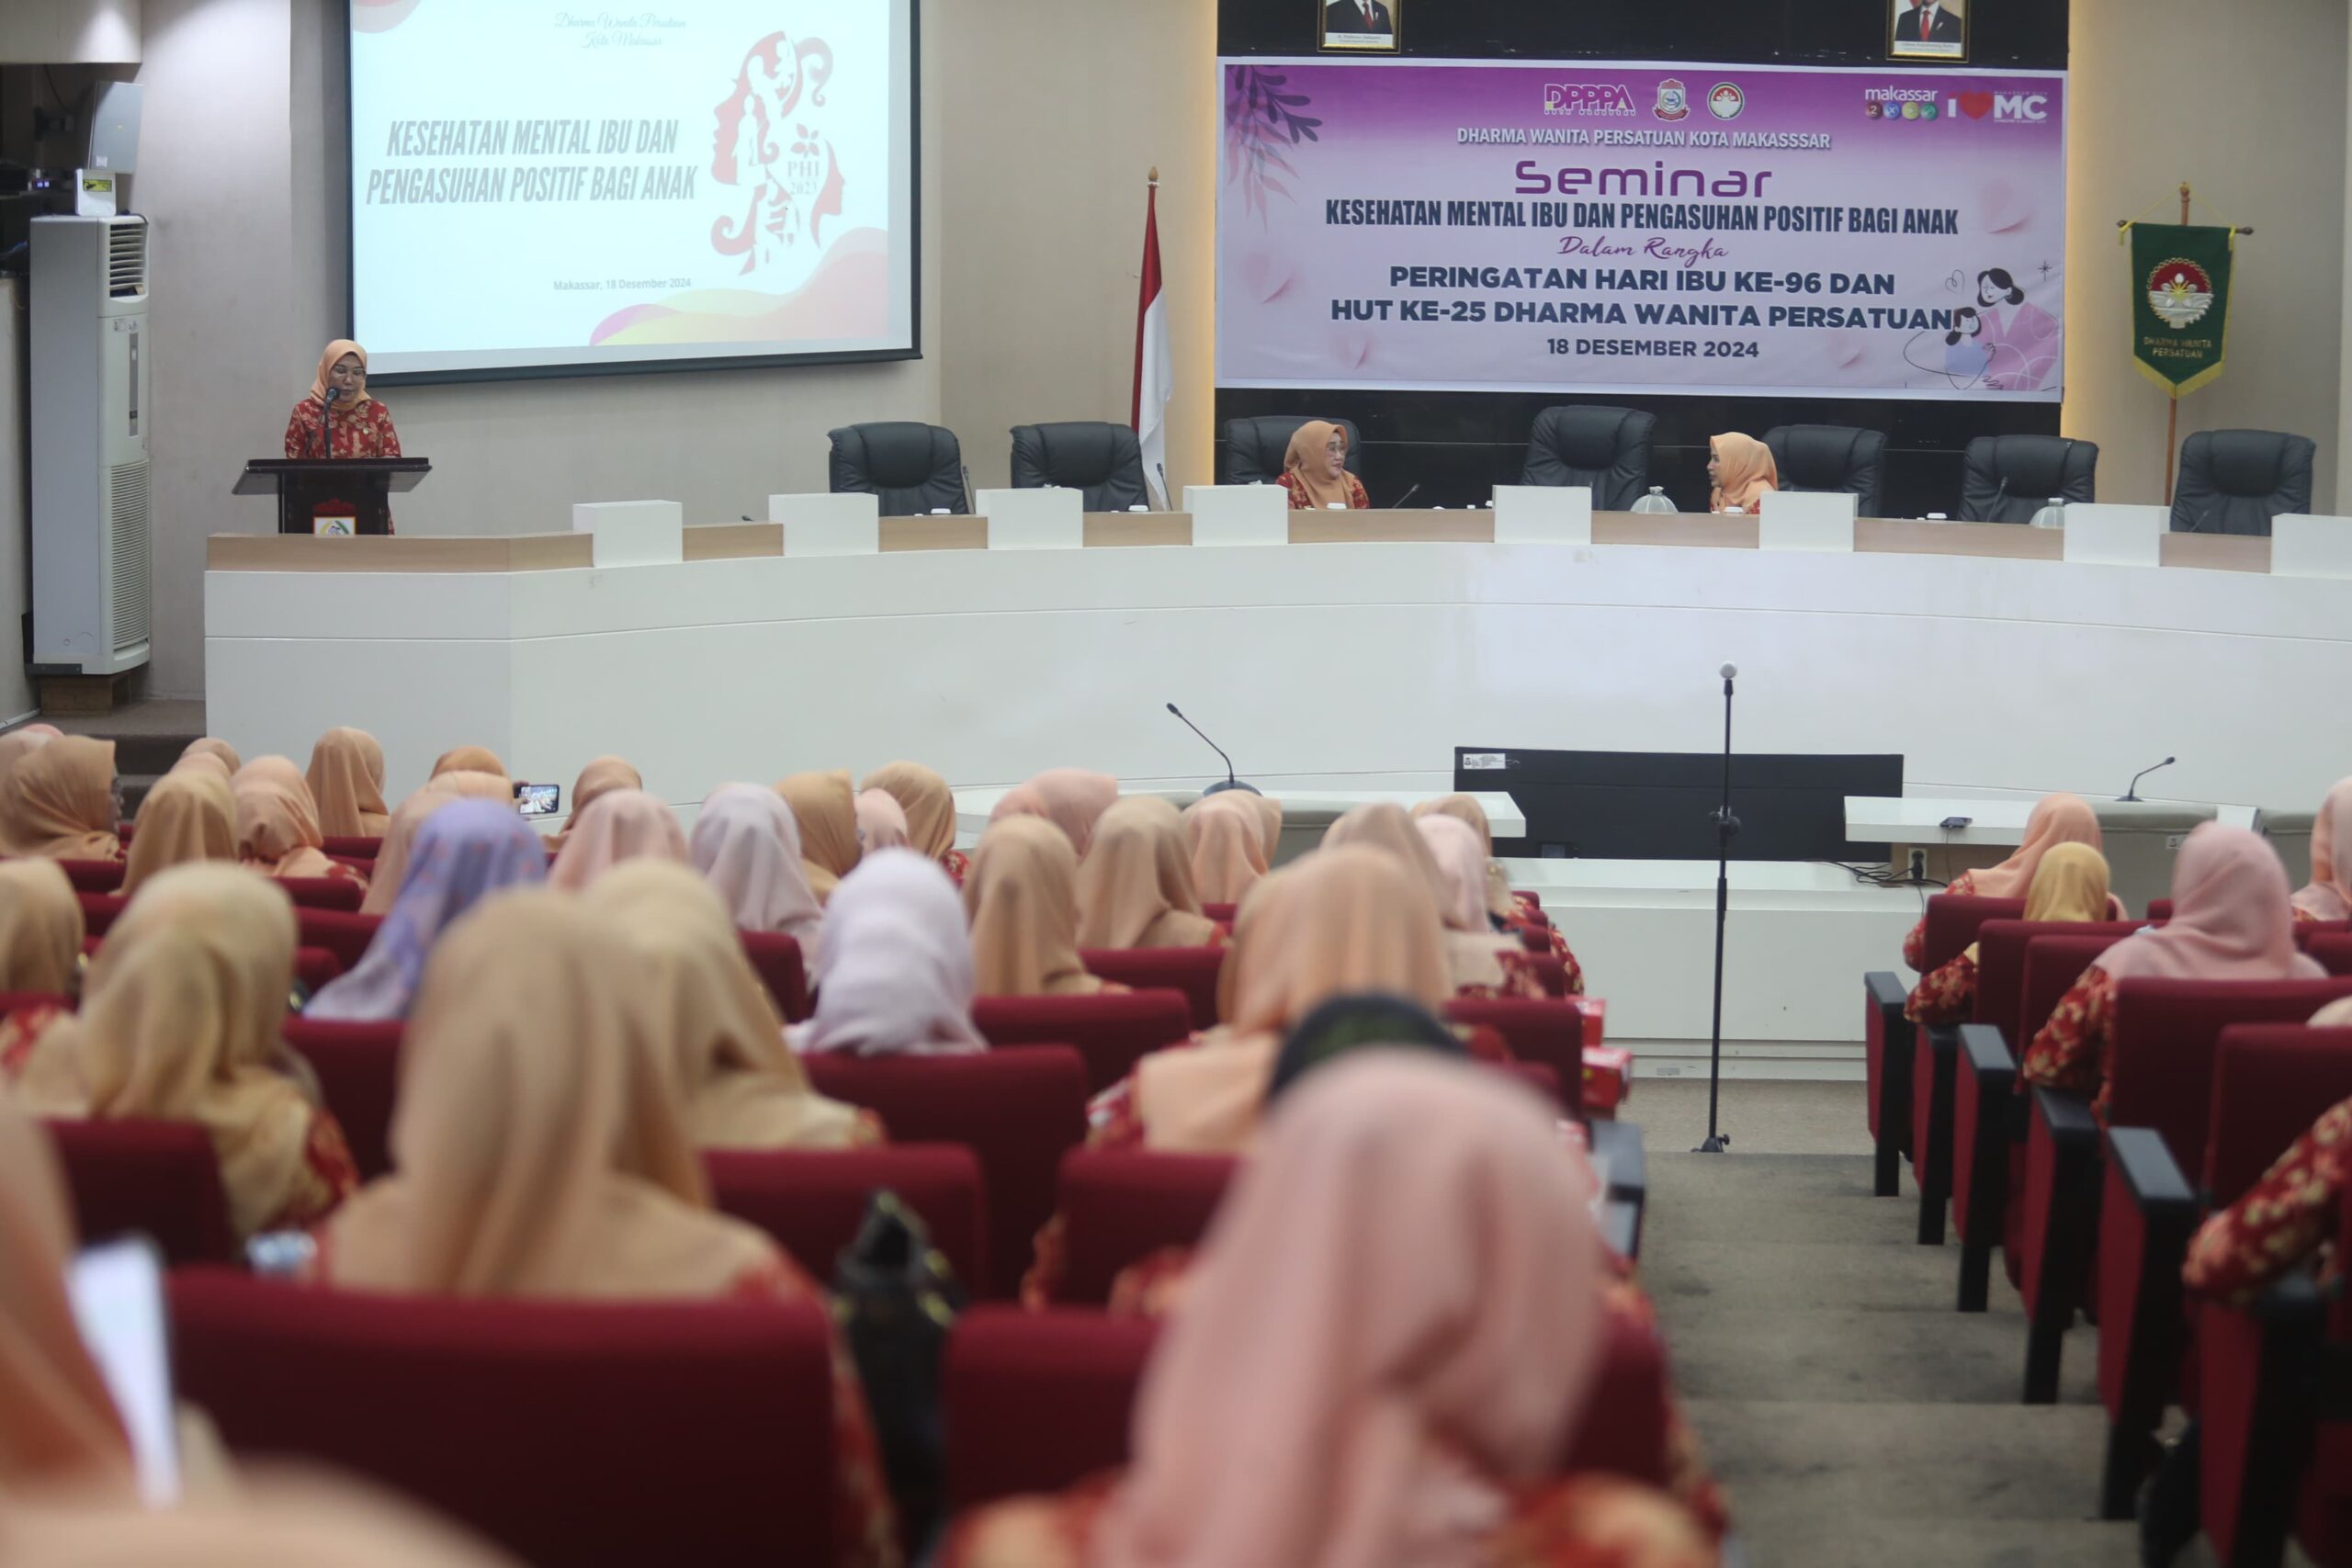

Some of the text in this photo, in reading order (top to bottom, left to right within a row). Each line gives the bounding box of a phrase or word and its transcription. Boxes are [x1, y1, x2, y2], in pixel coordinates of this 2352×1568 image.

[1544, 84, 1635, 111] DPPPA
[1865, 85, 1938, 102] makassar
[1994, 95, 2048, 120] MC
[387, 119, 679, 157] KESEHATAN MENTAL IBU DAN
[1457, 128, 1831, 149] DHARMA WANITA PERSATUAN KOTA MAKASSSAR
[786, 161, 820, 177] PHI
[1515, 160, 1772, 198] Seminar
[367, 165, 698, 205] PENGASUHAN POSITIF BAGI ANAK
[1326, 199, 1959, 235] KESEHATAN MENTAL IBU DAN PENGASUHAN POSITIF BAGI ANAK
[1556, 235, 1729, 268] Dalam Rangka
[553, 277, 692, 293] Makassar, 18 Desember 2024
[1390, 266, 1895, 295] PERINGATAN HARI IBU KE-96 DAN
[1331, 299, 1952, 330] HUT KE-25 DHARMA WANITA PERSATUAN
[1547, 339, 1759, 358] 18 DESEMBER 2024
[2152, 347, 2203, 359] PERSATUAN
